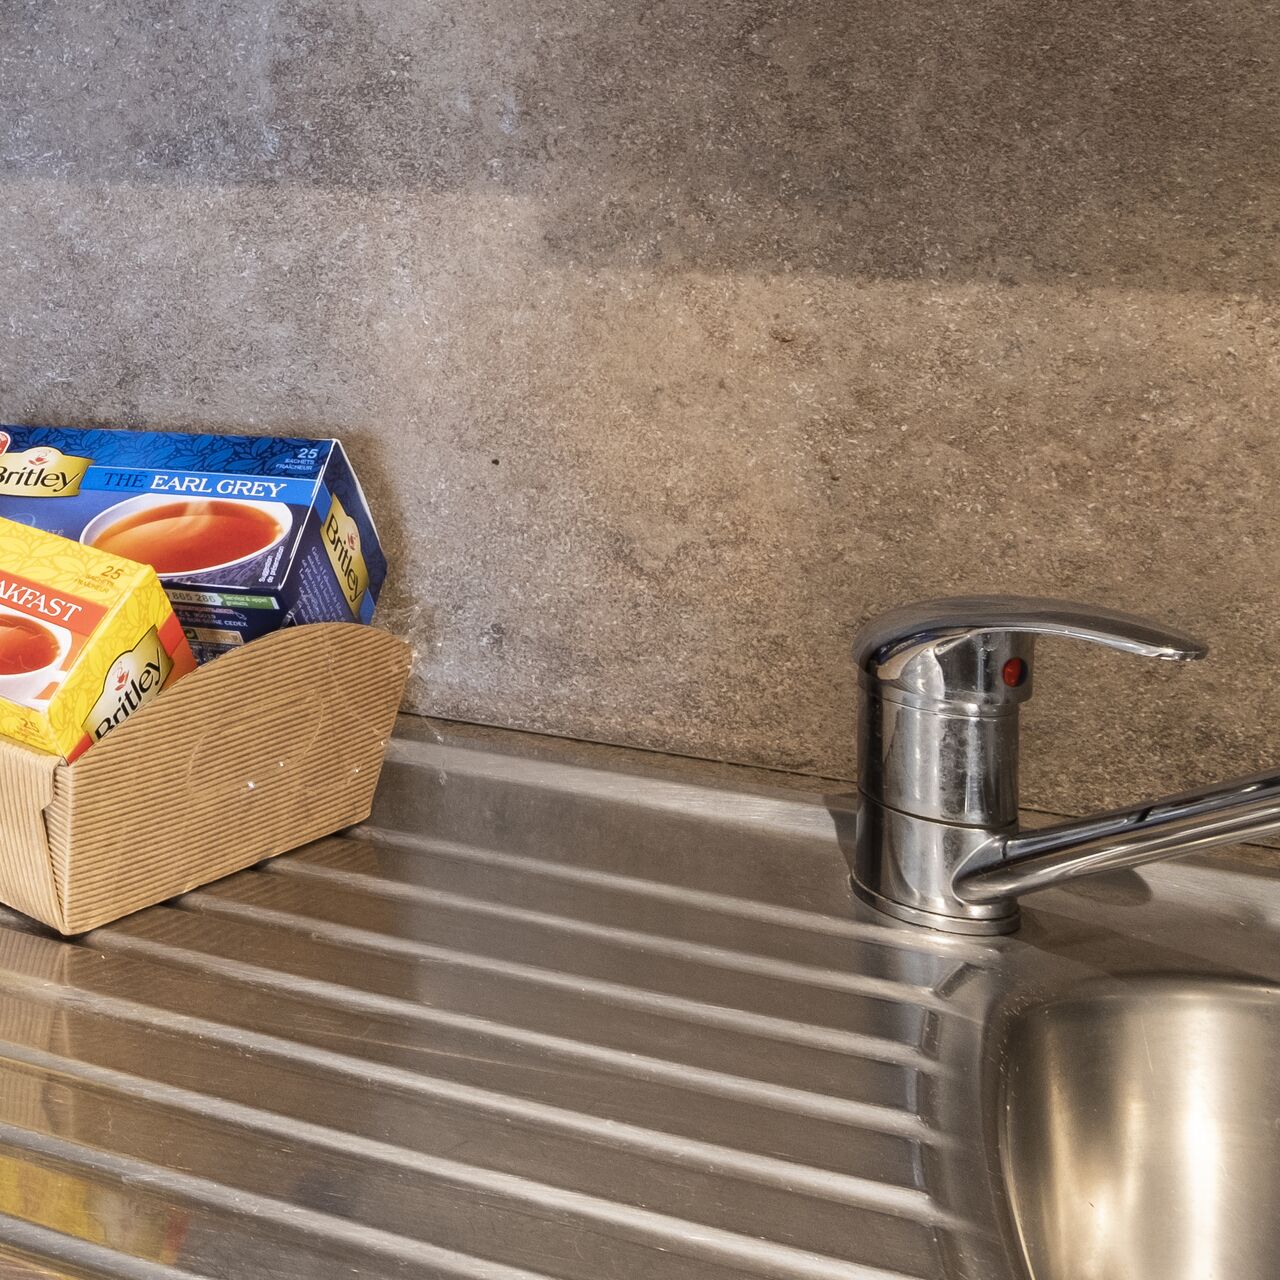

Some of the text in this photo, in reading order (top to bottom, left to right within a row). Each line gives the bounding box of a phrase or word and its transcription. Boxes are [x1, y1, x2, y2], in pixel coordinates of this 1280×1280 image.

[297, 448, 319, 459] 25
[150, 475, 212, 493] EARL
[217, 479, 287, 497] GREY
[326, 513, 363, 603] Britley
[101, 565, 124, 580] 25
[95, 648, 164, 741] Britley
